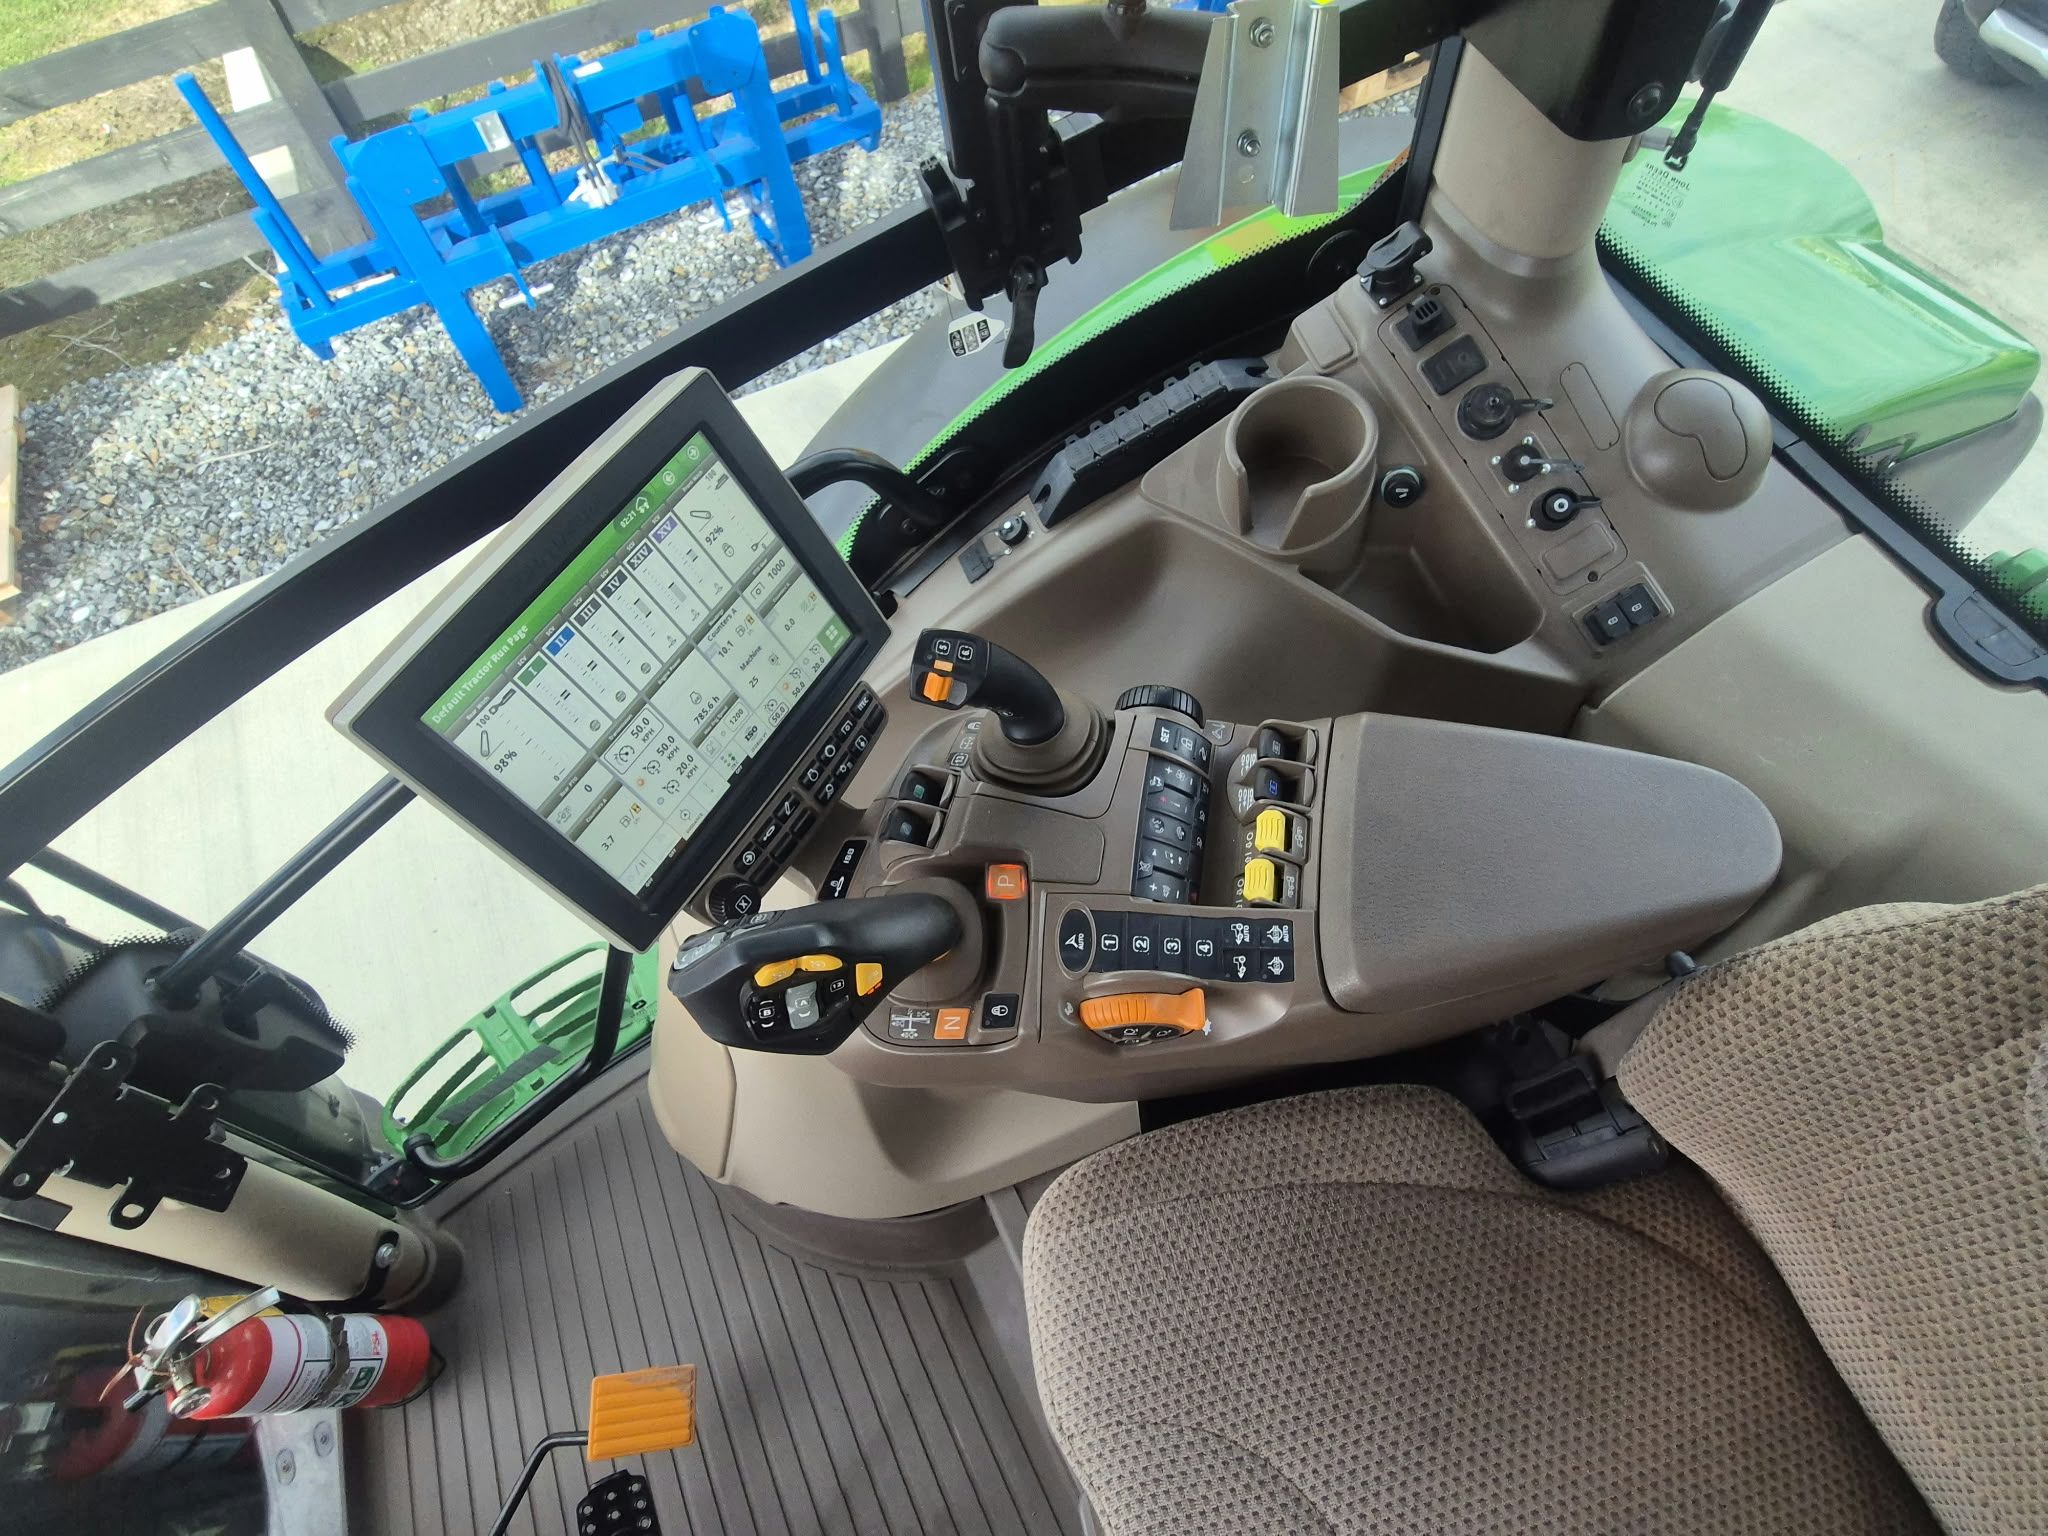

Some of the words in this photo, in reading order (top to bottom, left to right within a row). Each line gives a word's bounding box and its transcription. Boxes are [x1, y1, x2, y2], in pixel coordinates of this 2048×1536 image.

[618, 509, 637, 529] 02:21
[656, 520, 674, 540] XV
[703, 522, 725, 547] 92%
[628, 544, 651, 568] XIV
[766, 557, 786, 581] 1000
[605, 575, 622, 593] IV
[579, 603, 596, 621] III
[544, 624, 557, 637] SCV
[706, 612, 733, 642] Counters
[729, 606, 737, 615] A
[783, 616, 796, 632] 0.0
[553, 633, 568, 648] II
[717, 639, 734, 658] 10.1
[515, 654, 528, 667] SCV
[738, 643, 763, 671] Machine
[811, 655, 826, 673] 20.0
[430, 689, 467, 725] Default
[461, 659, 495, 693] Tractor
[489, 643, 511, 664] Run
[506, 622, 532, 648] Page
[526, 664, 539, 676] I
[747, 675, 760, 689] 25
[791, 680, 806, 698] 50.0
[692, 700, 715, 725] 785.6
[711, 693, 720, 703] h
[728, 707, 744, 726] 1200
[771, 705, 786, 723] 50.0
[474, 712, 492, 729] 100
[628, 715, 651, 739] 50.0
[640, 727, 656, 744] KPH
[743, 724, 759, 742] ISO
[1160, 726, 1170, 744] SET
[655, 734, 676, 757] 50.0
[666, 745, 680, 761] KPH
[491, 747, 519, 774] 98%
[674, 753, 695, 775] 20.0
[552, 774, 561, 782] 0
[685, 763, 699, 779] KPH
[582, 782, 594, 794] 0
[600, 834, 616, 851] 3.7
[997, 874, 1015, 887] P
[1078, 933, 1086, 950] AUTO
[943, 1015, 961, 1030] N
